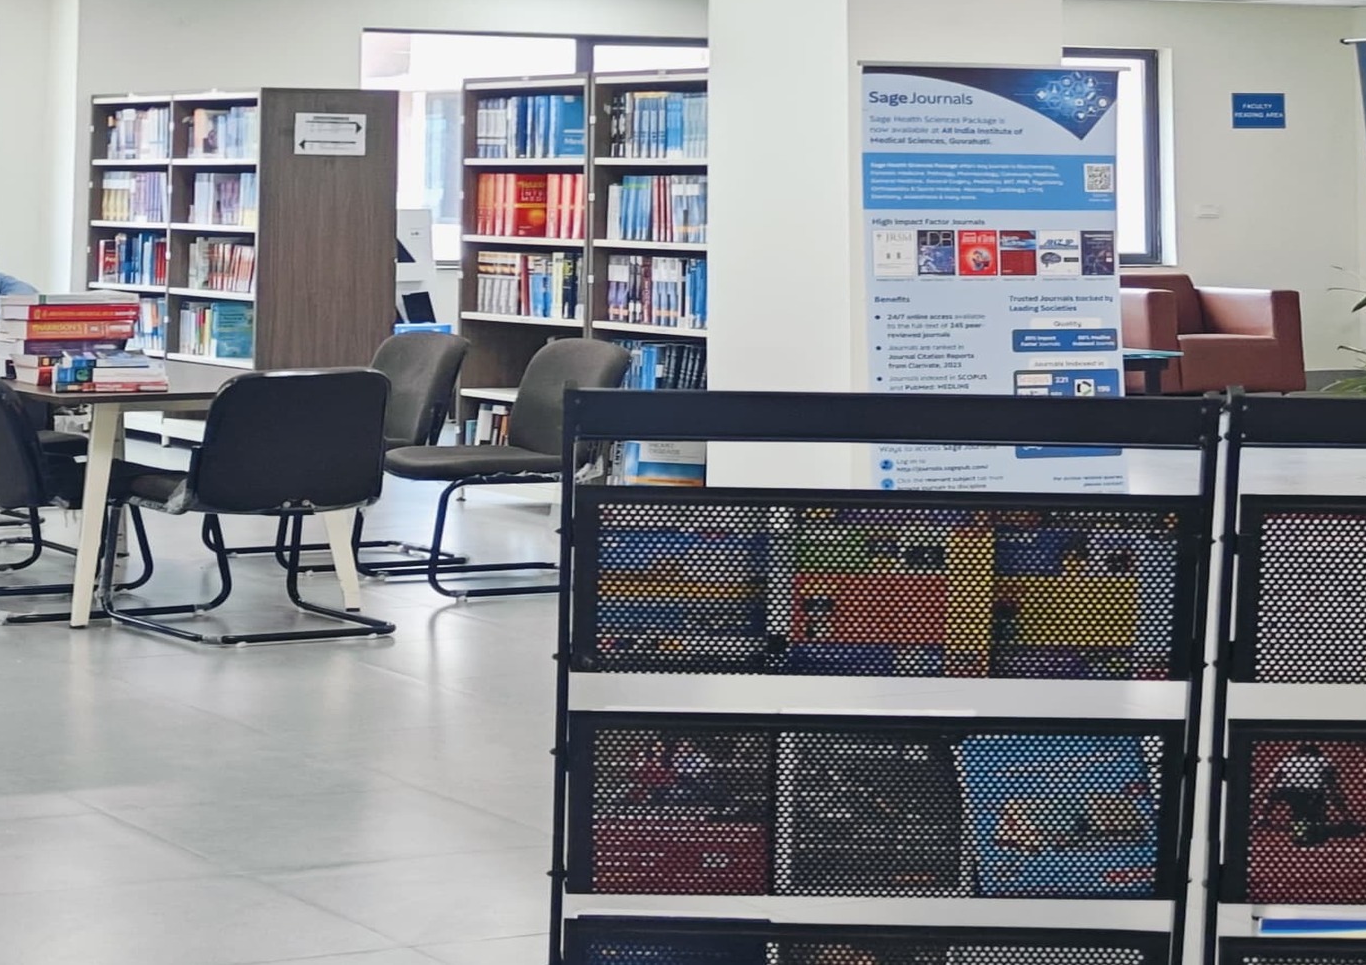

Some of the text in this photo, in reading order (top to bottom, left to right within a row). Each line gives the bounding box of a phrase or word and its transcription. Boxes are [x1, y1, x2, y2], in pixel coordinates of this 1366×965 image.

[868, 91, 973, 107] Sage Journals
[869, 115, 891, 124] Sage
[962, 117, 997, 125] Package
[1009, 305, 1039, 313] Leading
